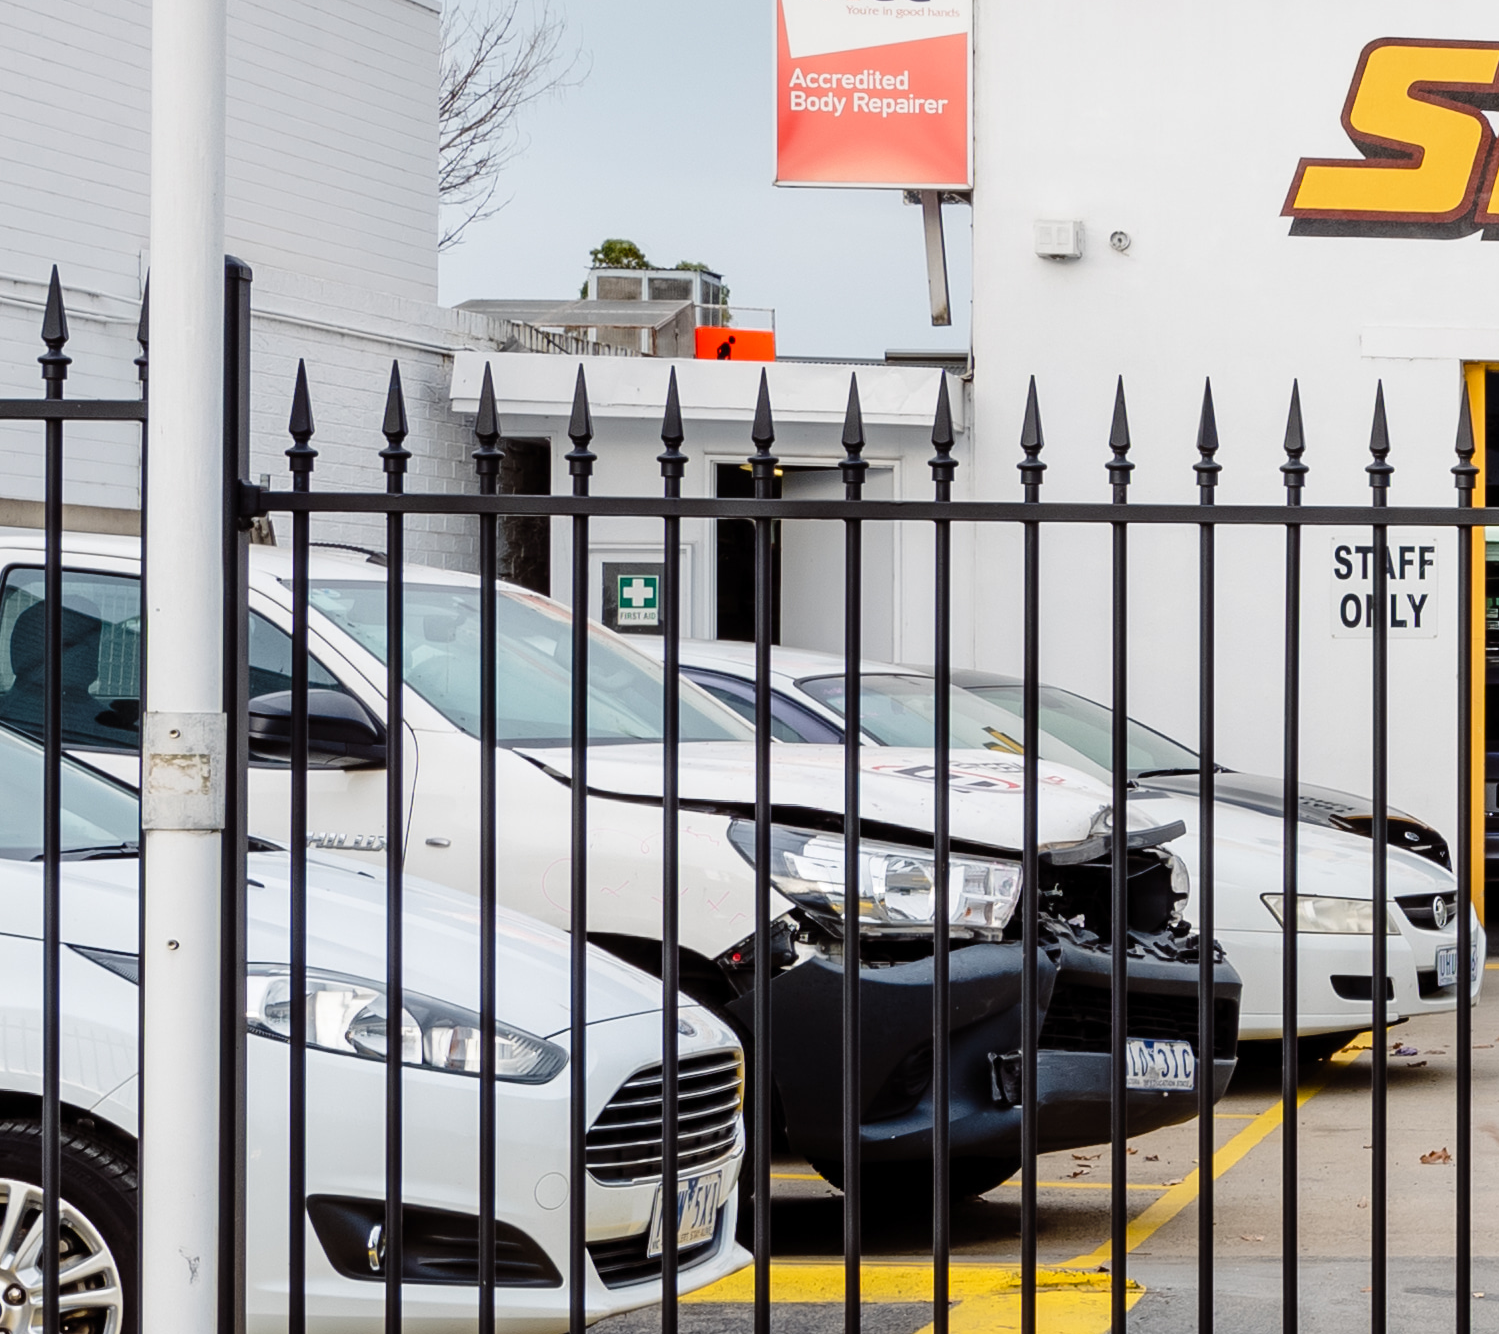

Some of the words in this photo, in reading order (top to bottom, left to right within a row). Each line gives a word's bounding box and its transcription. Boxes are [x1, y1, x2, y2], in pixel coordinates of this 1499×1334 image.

[883, 6, 893, 16] in
[895, 7, 925, 18] good
[928, 7, 960, 18] hands
[789, 67, 909, 90] Accredited
[790, 91, 846, 117] Body
[853, 92, 948, 118] Repairer
[620, 612, 641, 620] FIRST
[643, 612, 656, 620] AID
